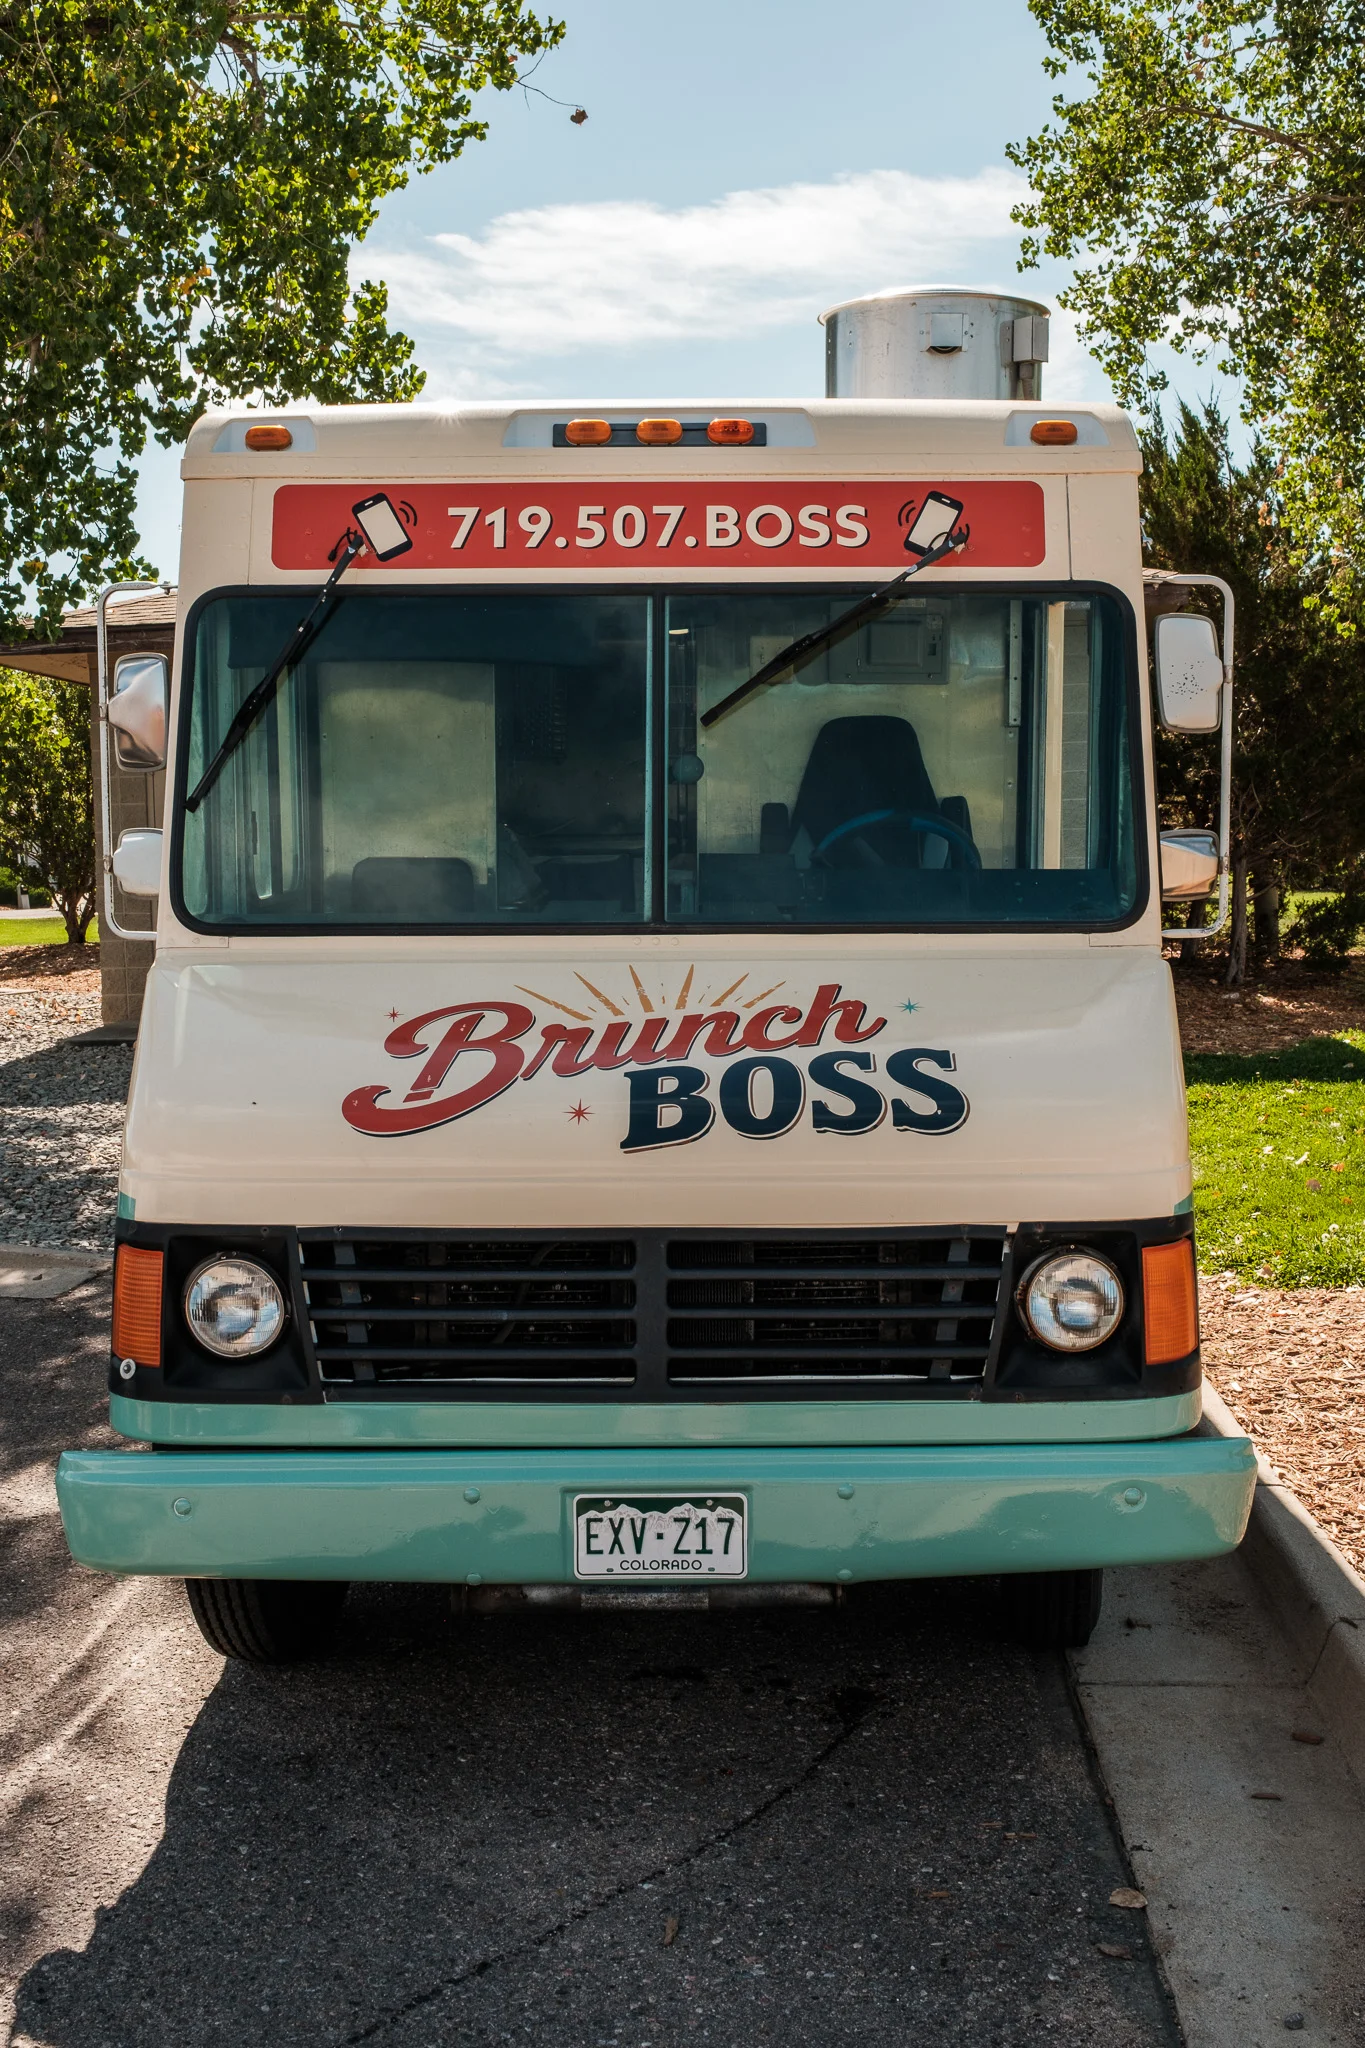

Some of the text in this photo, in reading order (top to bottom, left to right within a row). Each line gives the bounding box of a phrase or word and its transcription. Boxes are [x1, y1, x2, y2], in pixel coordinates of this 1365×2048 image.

[447, 504, 870, 549] 719.507.BOSS
[341, 984, 887, 1138] Brunch
[619, 1048, 971, 1154] BOSS
[620, 1559, 702, 1571] COLORADO
